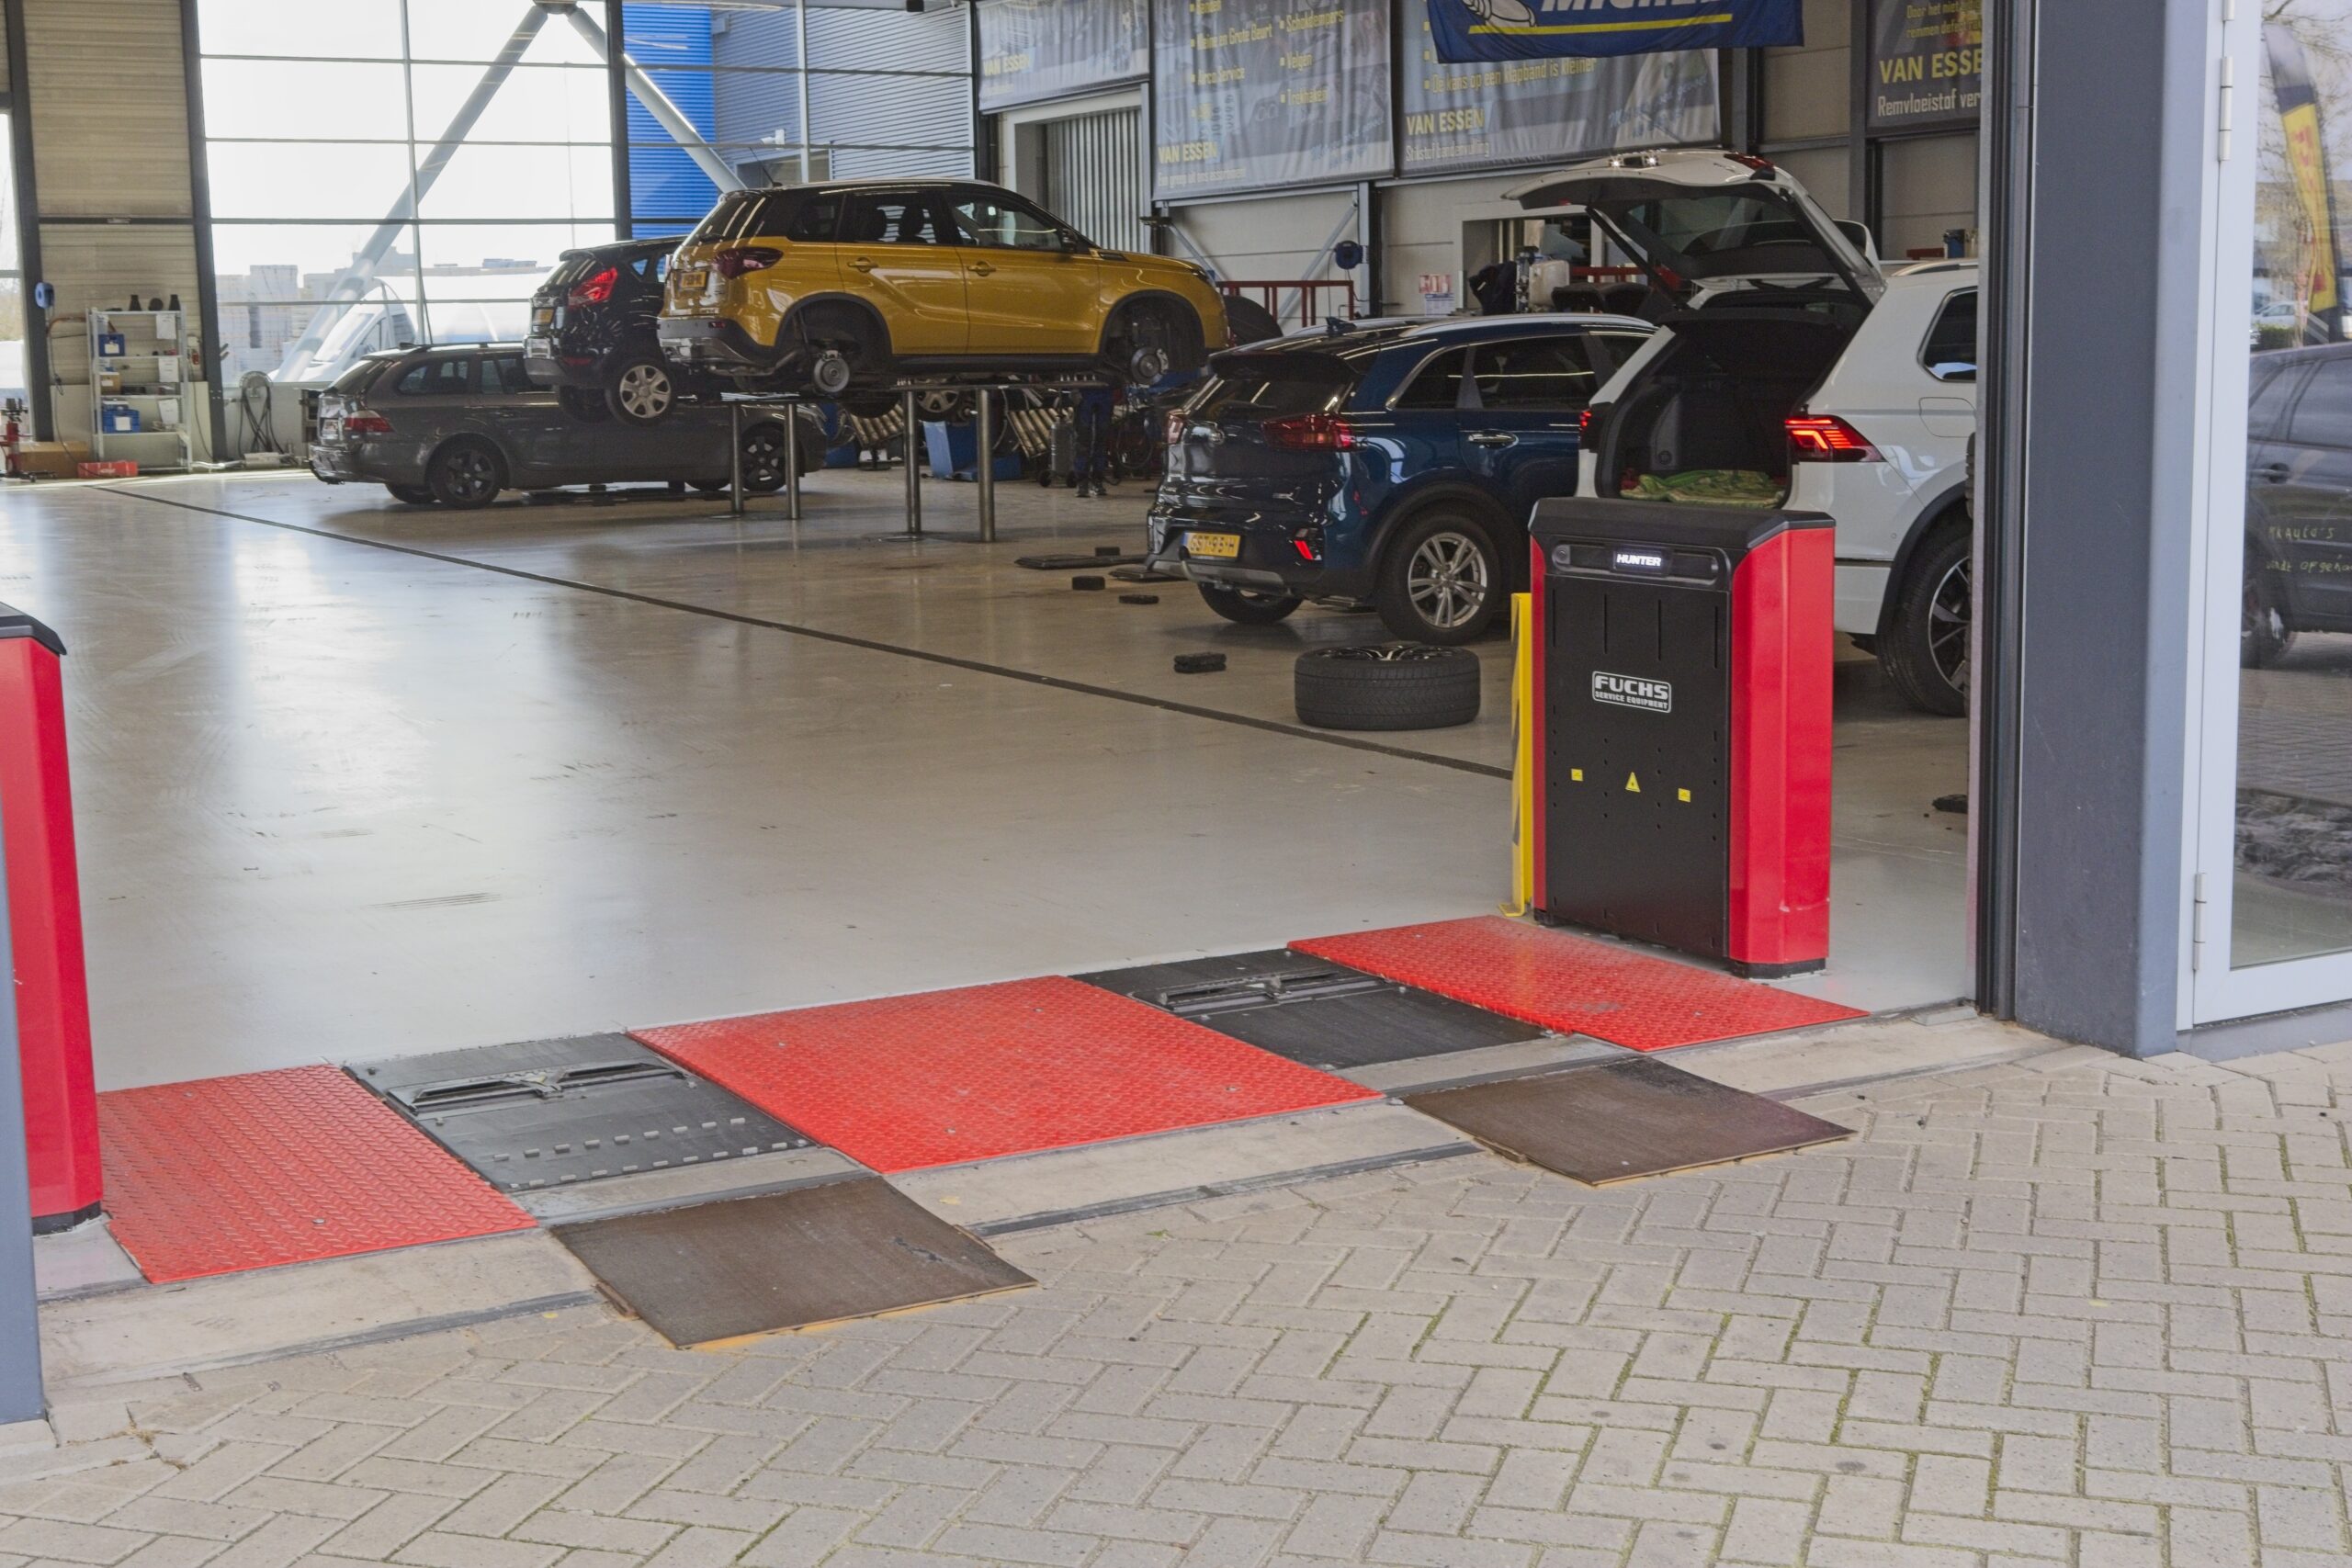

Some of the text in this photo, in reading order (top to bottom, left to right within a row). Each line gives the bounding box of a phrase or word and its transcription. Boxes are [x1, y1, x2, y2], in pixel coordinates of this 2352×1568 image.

[1229, 27, 1250, 44] Grote
[1250, 23, 1272, 40] Beurt
[983, 53, 1030, 76] VAN ESSEN
[1879, 56, 1924, 84] VAN
[1432, 73, 1443, 93] De
[1470, 73, 1482, 92] op
[1484, 72, 1501, 87] een
[1550, 62, 1559, 77] is
[1878, 88, 1957, 117] Remvloeistof
[1406, 108, 1485, 136] VAN ESSEN
[1158, 141, 1217, 164] VAN ESSEN
[1617, 553, 1662, 567] HUNTER
[1595, 675, 1669, 700] FUCHS
[1595, 690, 1668, 710] SERVICE EQUIPMENT
